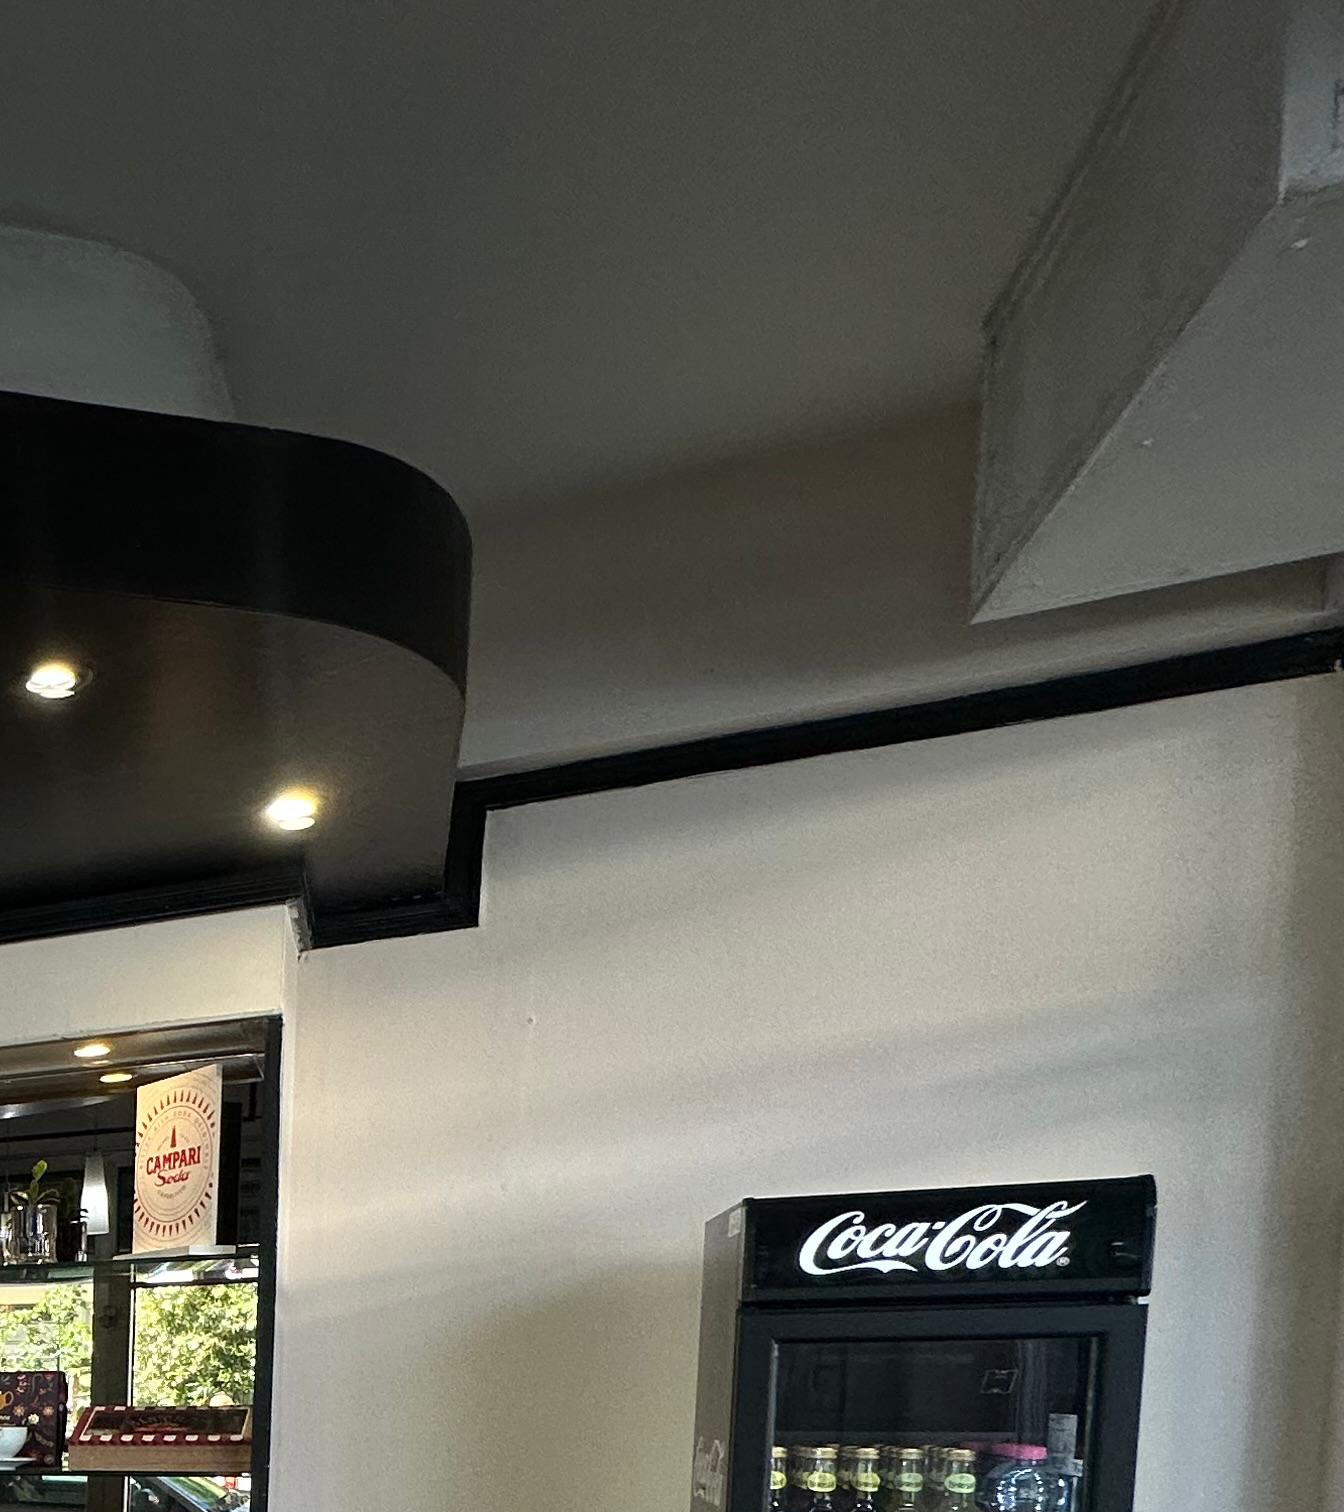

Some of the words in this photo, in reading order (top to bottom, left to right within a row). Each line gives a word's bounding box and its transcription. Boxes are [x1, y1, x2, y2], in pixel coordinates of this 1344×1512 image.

[146, 1145, 201, 1175] CAMPARI
[154, 1169, 191, 1187] Soda
[799, 1201, 1088, 1275] Coca-Cola
